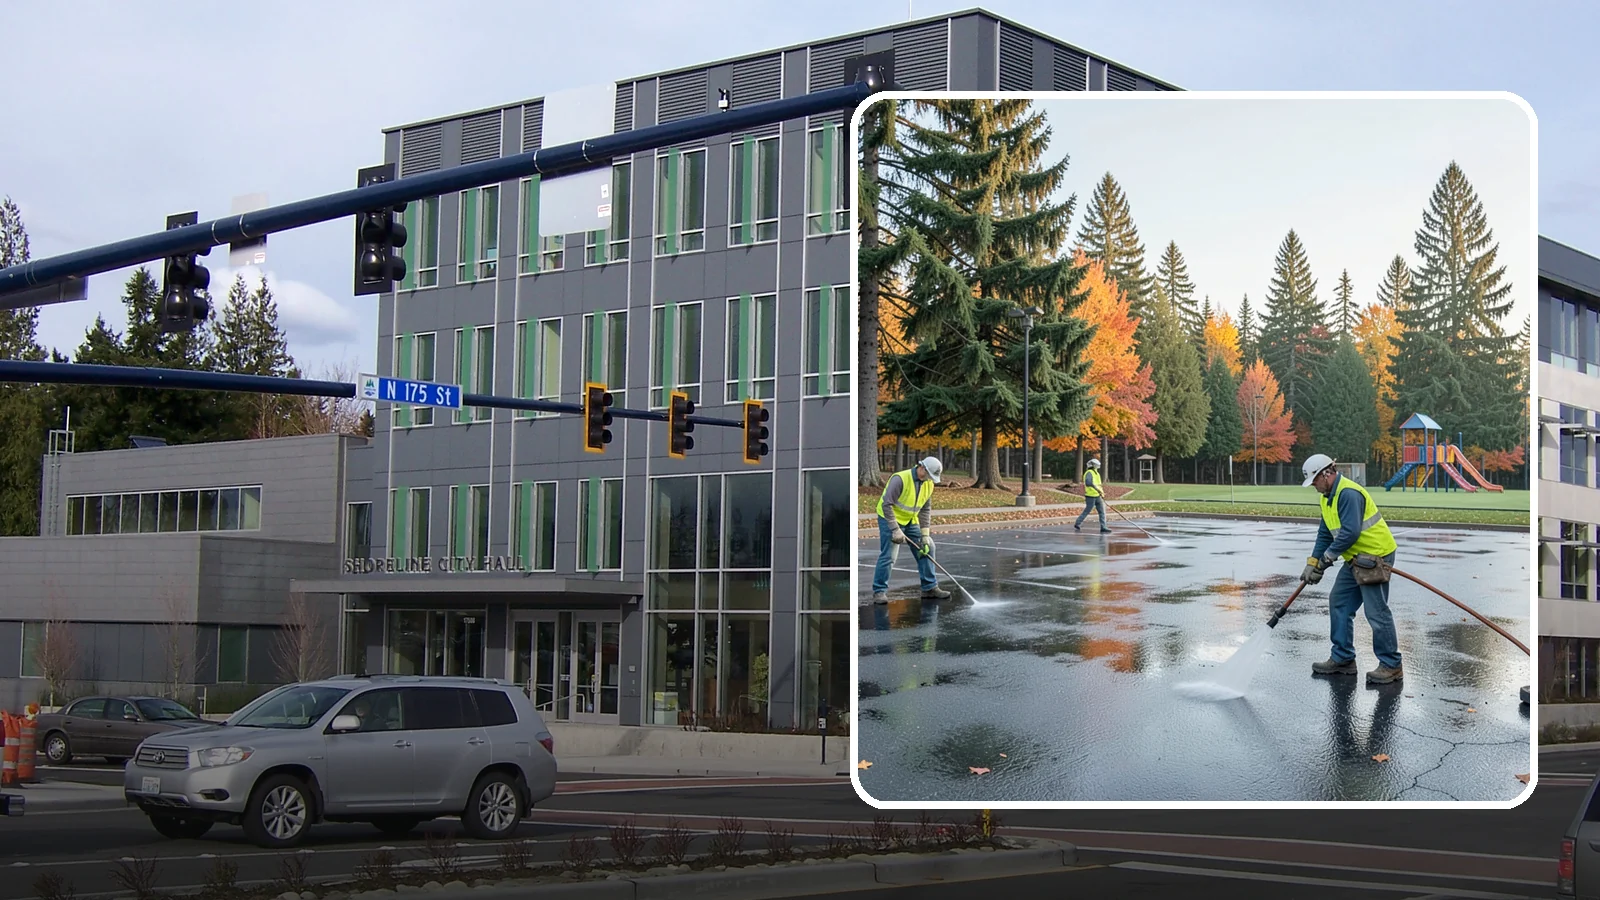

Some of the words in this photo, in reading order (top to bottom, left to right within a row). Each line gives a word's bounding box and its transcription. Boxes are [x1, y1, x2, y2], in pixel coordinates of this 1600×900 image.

[387, 380, 396, 400] N
[405, 382, 427, 403] 175
[436, 386, 451, 406] St
[344, 556, 432, 574] SHORELINE
[438, 556, 475, 572] CITY
[484, 556, 526, 571] HALL
